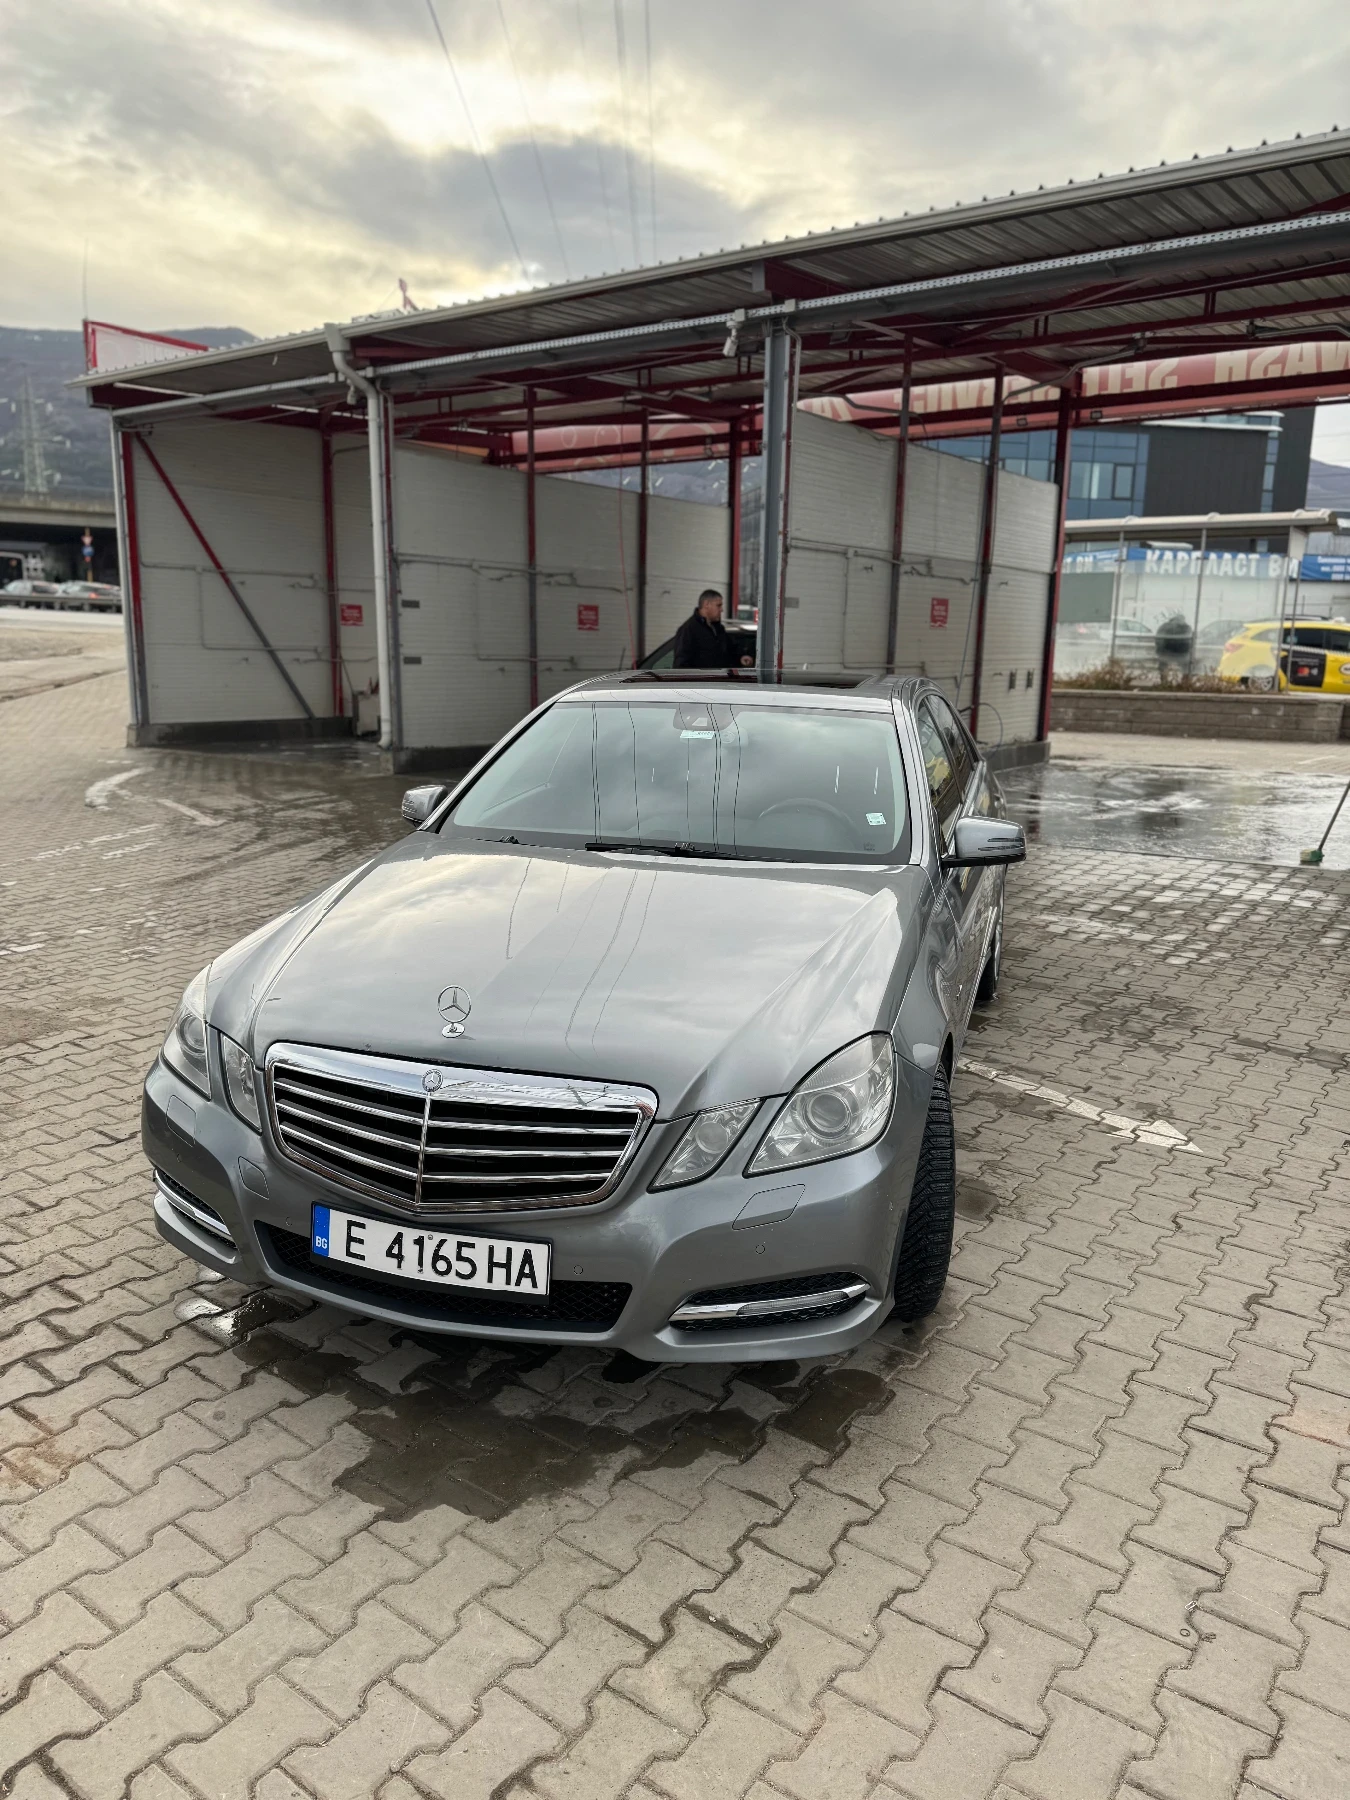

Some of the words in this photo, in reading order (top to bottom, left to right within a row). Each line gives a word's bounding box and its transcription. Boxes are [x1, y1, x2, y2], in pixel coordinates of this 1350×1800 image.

[315, 1235, 329, 1250] BG
[345, 1219, 367, 1262] E
[385, 1231, 478, 1280] 4165
[487, 1244, 539, 1289] HA
